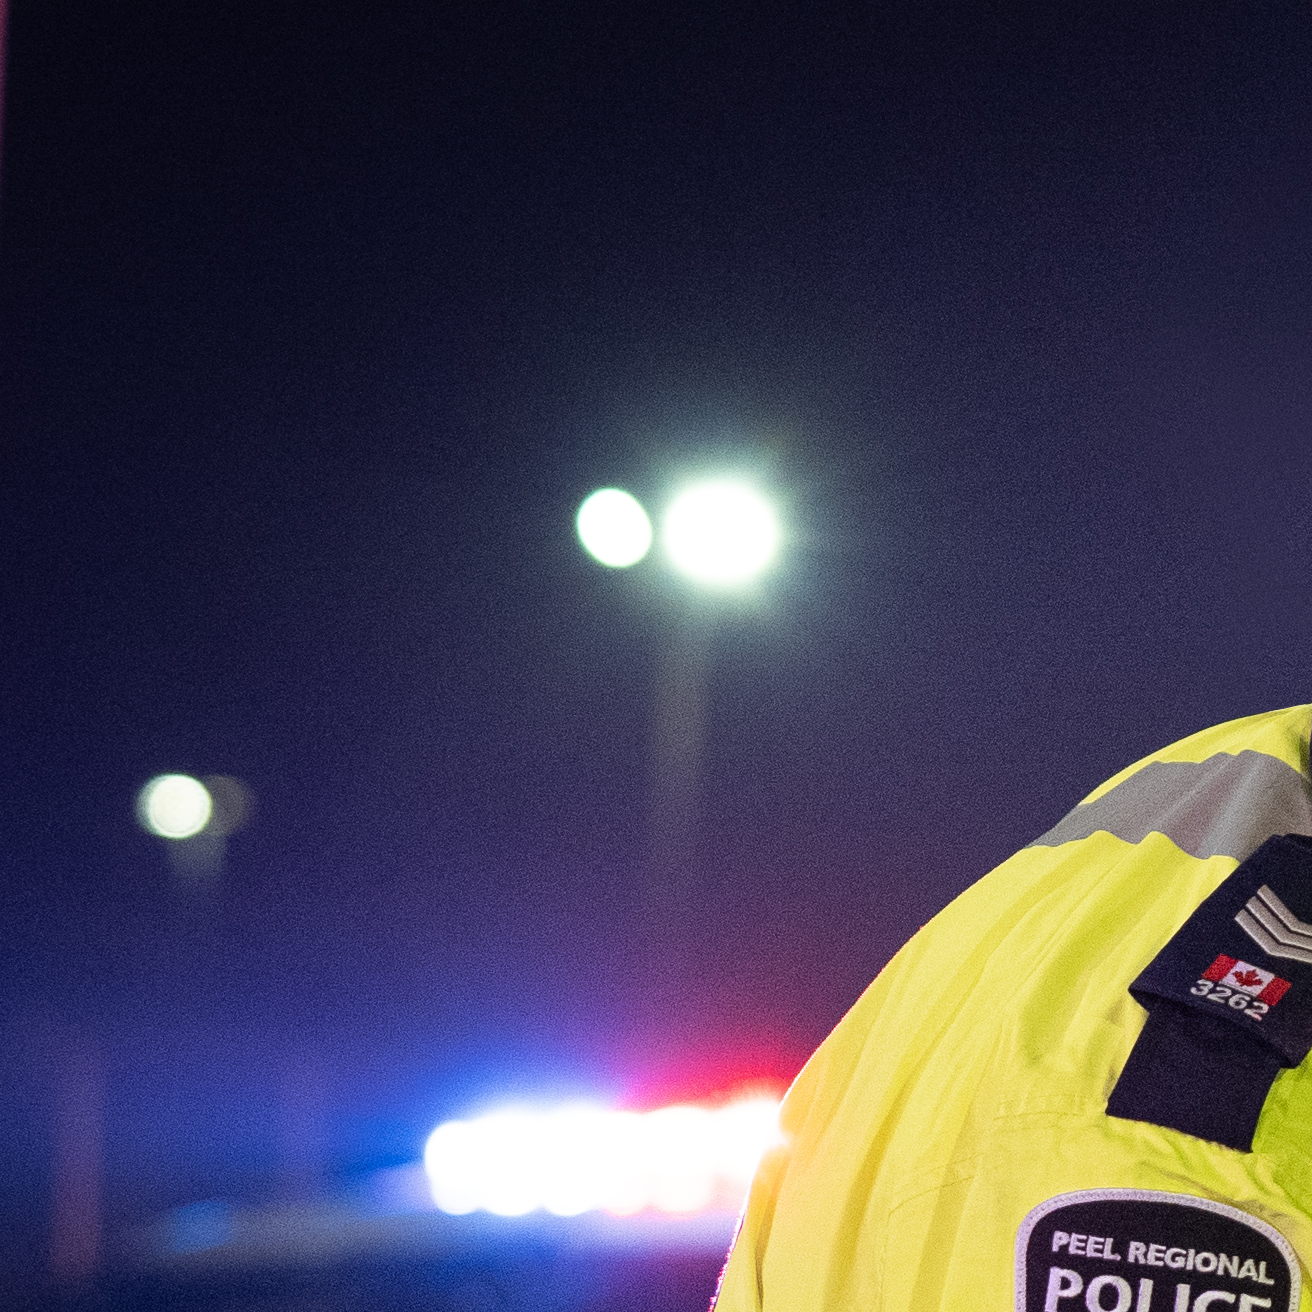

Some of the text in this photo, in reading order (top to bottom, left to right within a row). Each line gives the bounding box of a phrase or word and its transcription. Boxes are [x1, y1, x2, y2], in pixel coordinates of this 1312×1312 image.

[1189, 979, 1270, 1022] 3262
[1051, 1230, 1275, 1286] PEEL REGIONAL
